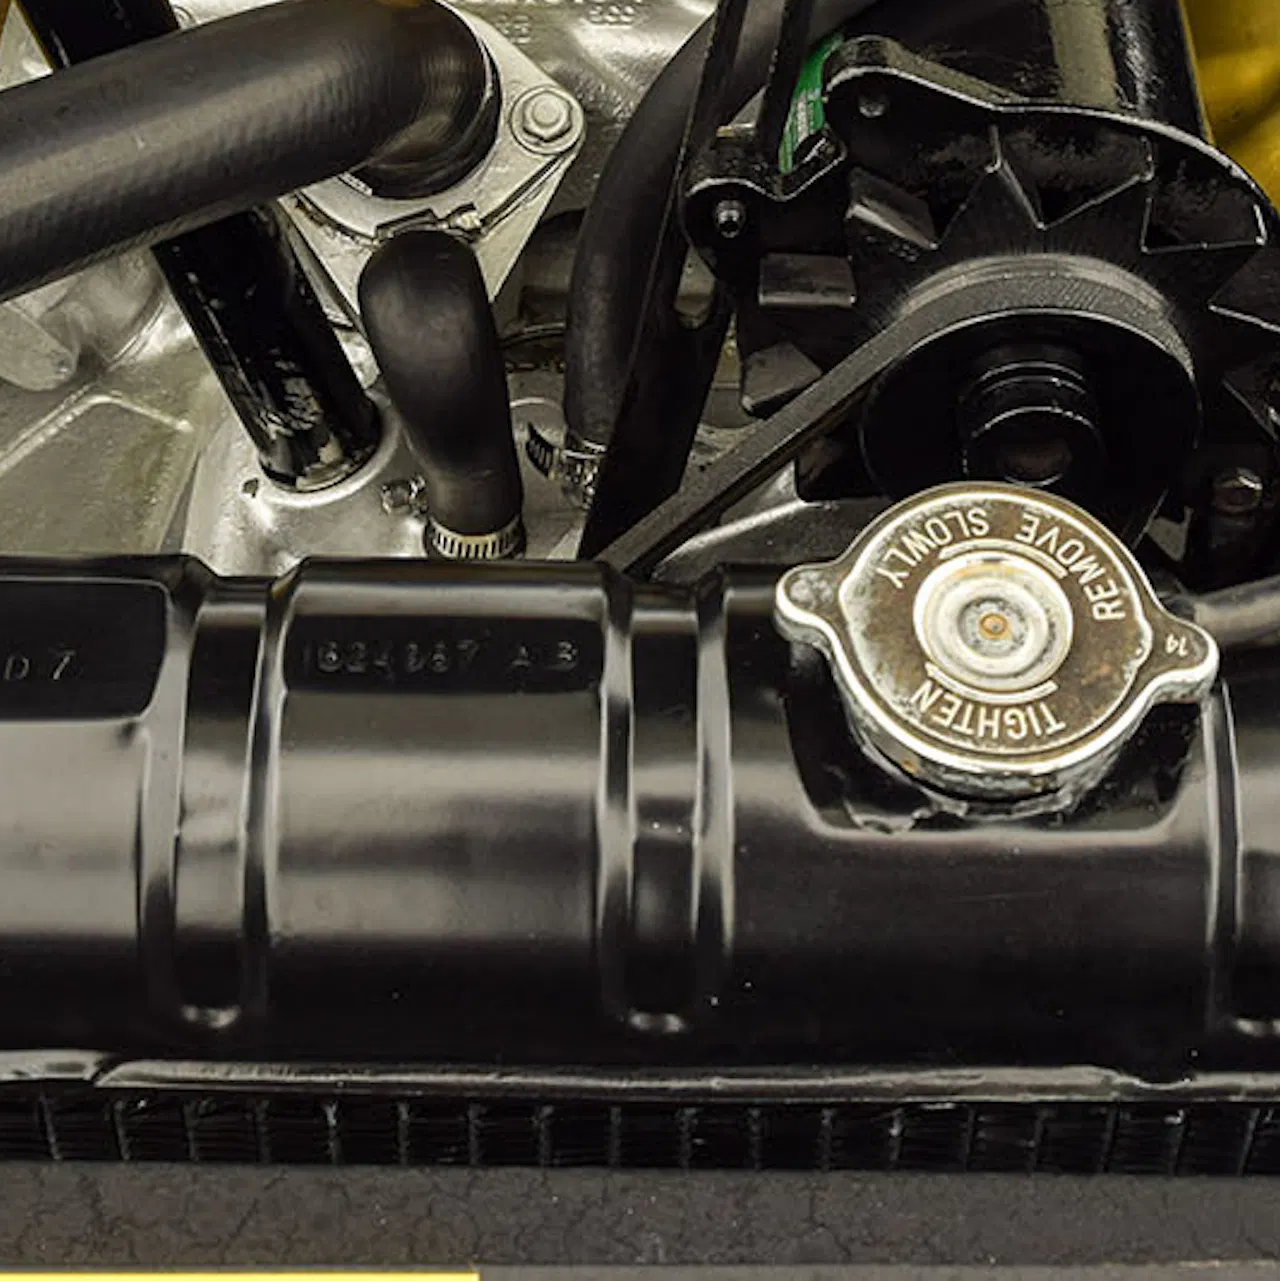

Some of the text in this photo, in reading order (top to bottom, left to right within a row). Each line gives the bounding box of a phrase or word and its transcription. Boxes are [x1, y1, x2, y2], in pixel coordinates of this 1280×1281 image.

[873, 506, 1126, 621] REMOVE SLOWLY
[908, 678, 1067, 742] TIGHTEN
